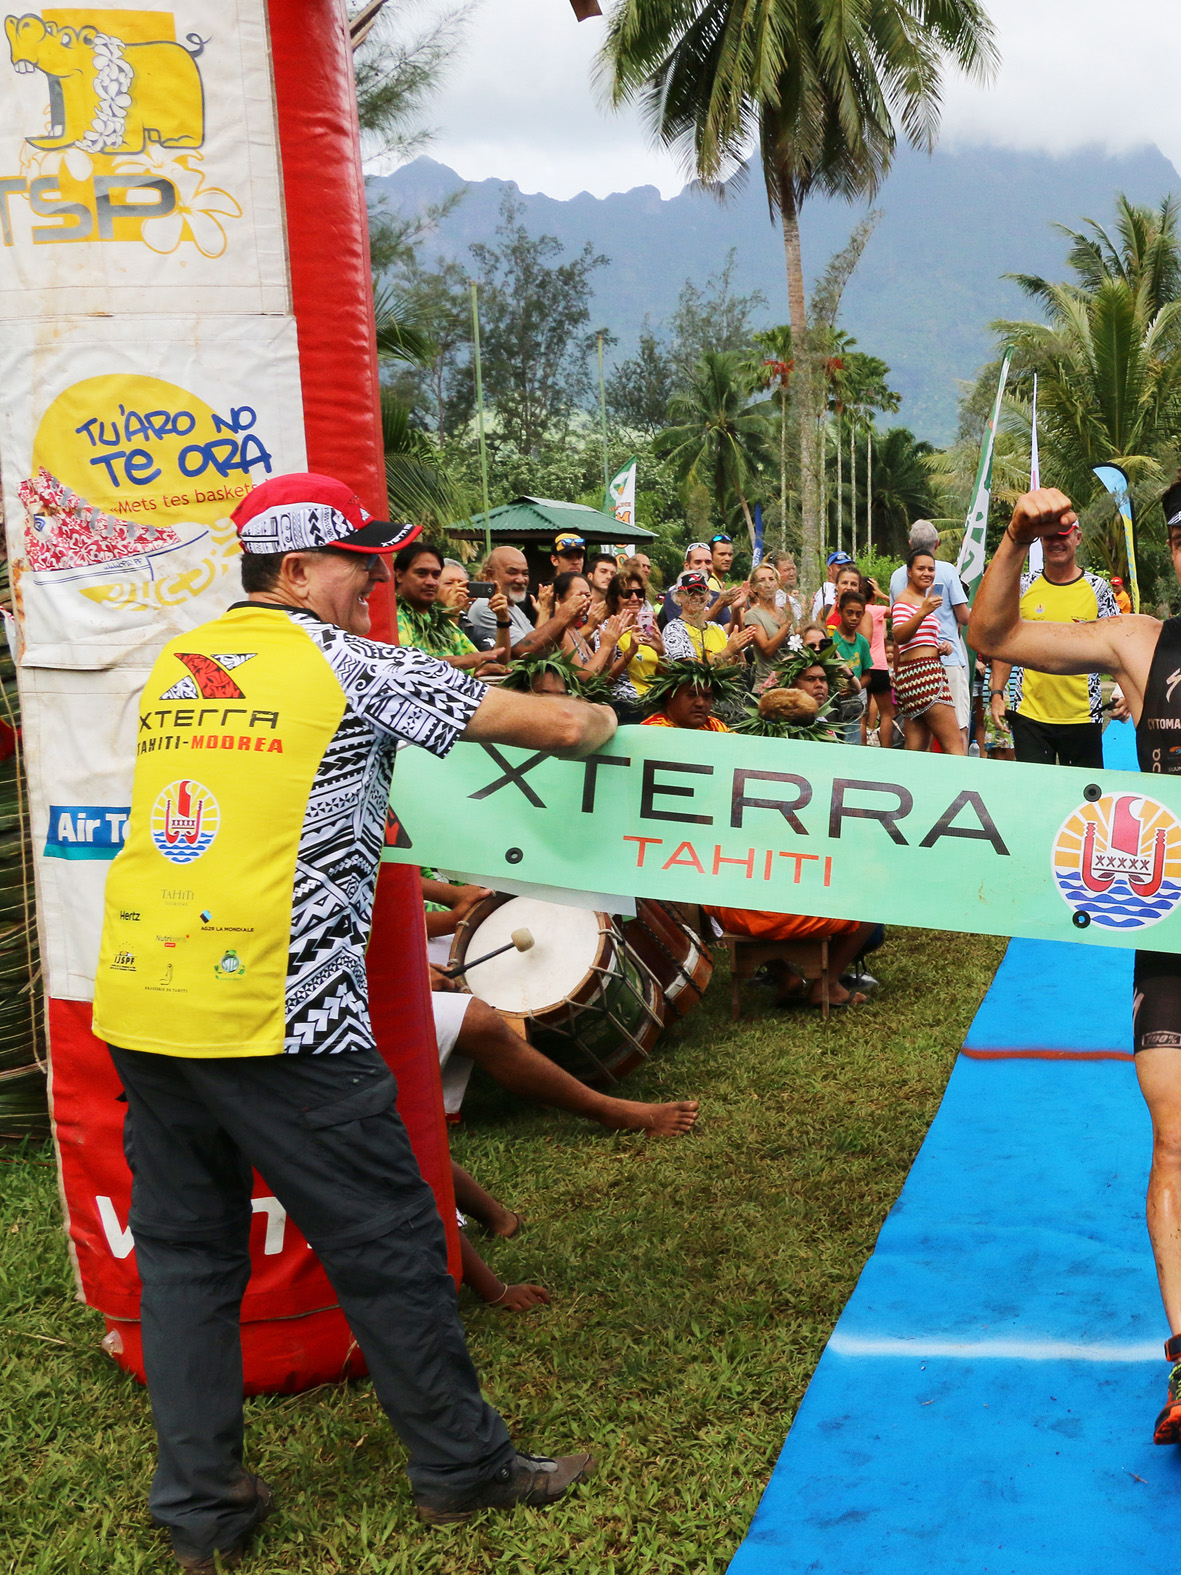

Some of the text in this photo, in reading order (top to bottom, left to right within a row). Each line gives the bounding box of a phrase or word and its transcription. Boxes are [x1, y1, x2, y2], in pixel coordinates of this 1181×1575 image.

[211, 405, 257, 434] NO
[178, 433, 272, 477] ORA
[163, 493, 190, 508] tes
[139, 708, 279, 733] XTERRA
[467, 742, 1011, 856] XTERRA
[58, 812, 101, 842] Air
[623, 834, 833, 888] TAHITI
[120, 910, 141, 921] Hertz
